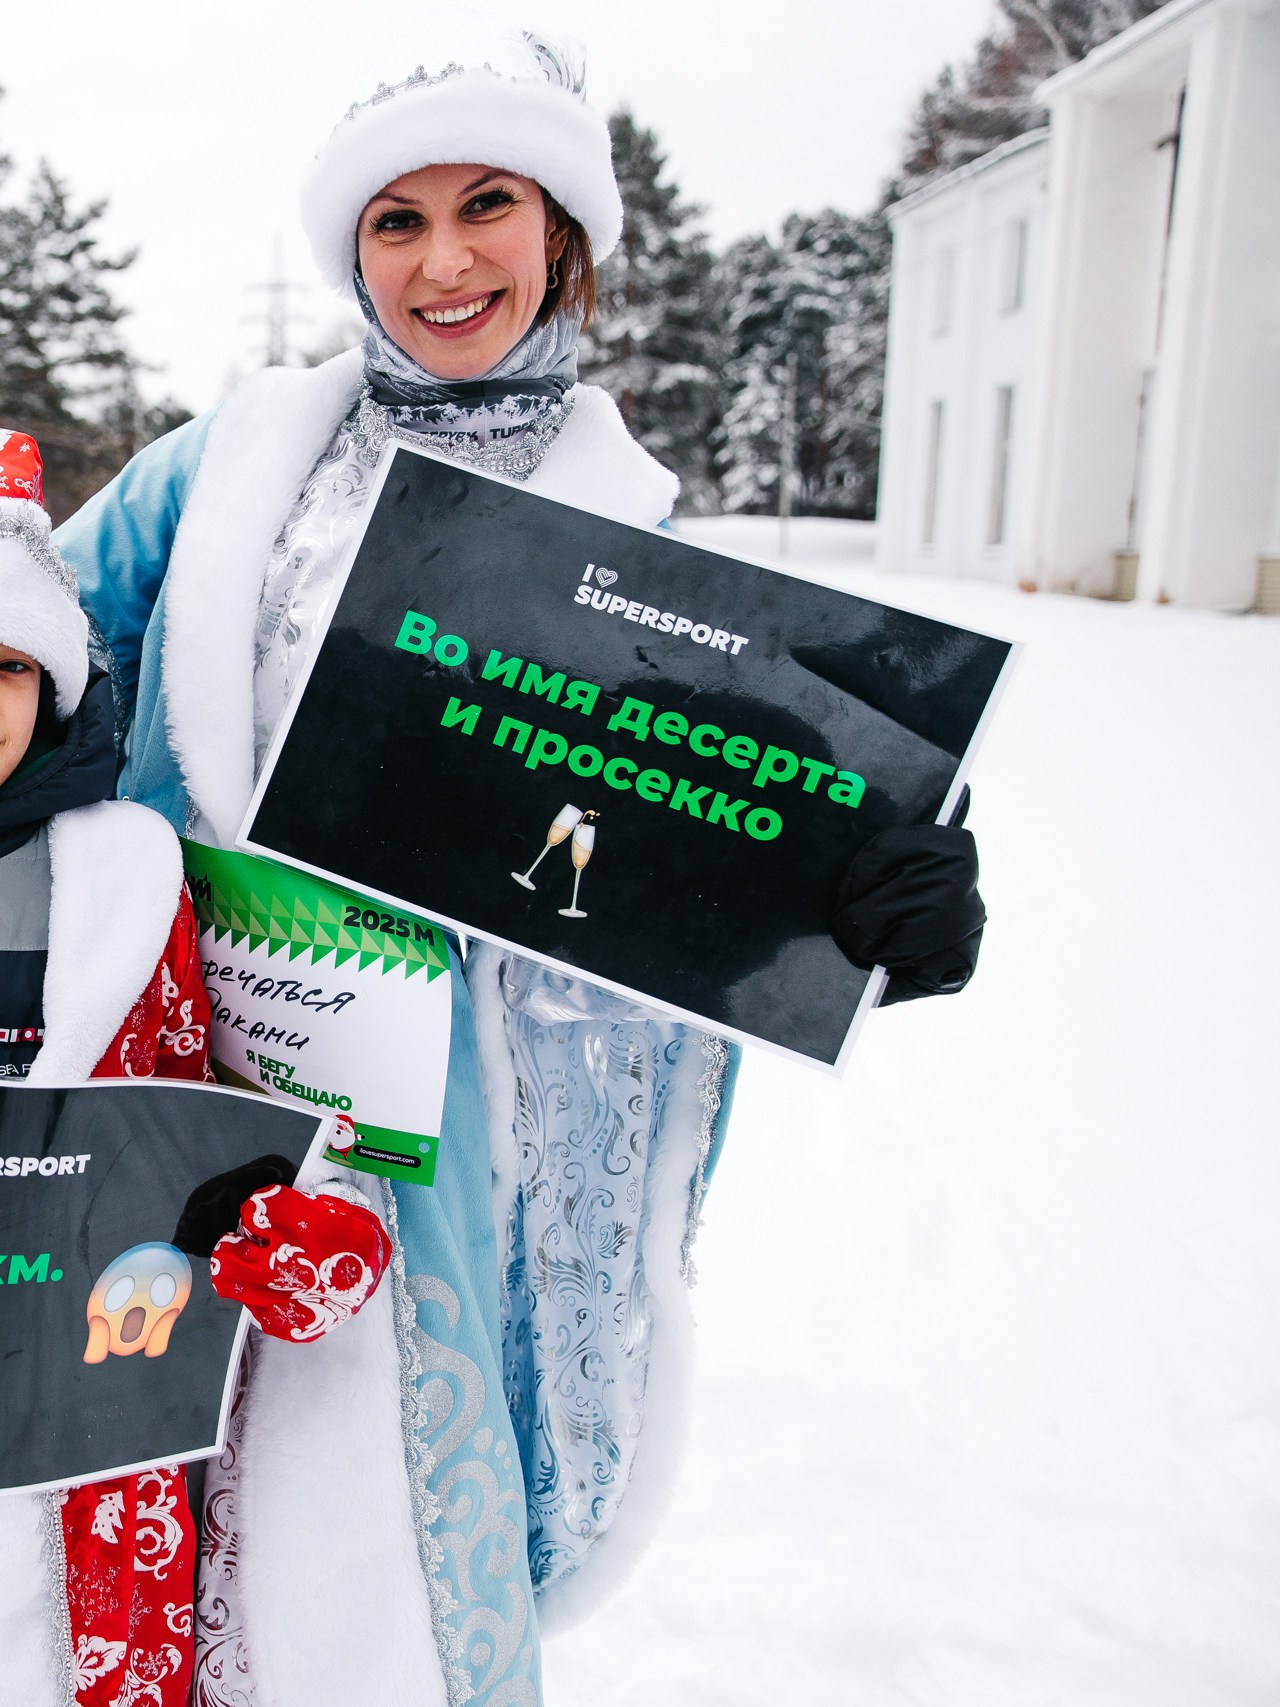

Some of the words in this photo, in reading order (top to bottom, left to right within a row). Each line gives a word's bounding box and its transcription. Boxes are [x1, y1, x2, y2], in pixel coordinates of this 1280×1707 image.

[580, 563, 595, 587] I
[573, 584, 750, 656] SUPERSPORT
[394, 609, 469, 667] Во
[481, 649, 601, 716] имя
[606, 696, 866, 809] десерта
[440, 696, 483, 736] и
[492, 715, 783, 841] просекко
[343, 905, 410, 938] 2025
[413, 922, 435, 947] М
[245, 1049, 256, 1064] Я
[258, 1053, 296, 1079] БЕГУ
[259, 1068, 271, 1085] И
[272, 1075, 353, 1112] ОБЕЩАЮ
[359, 1147, 415, 1164] ilovesupersport.com
